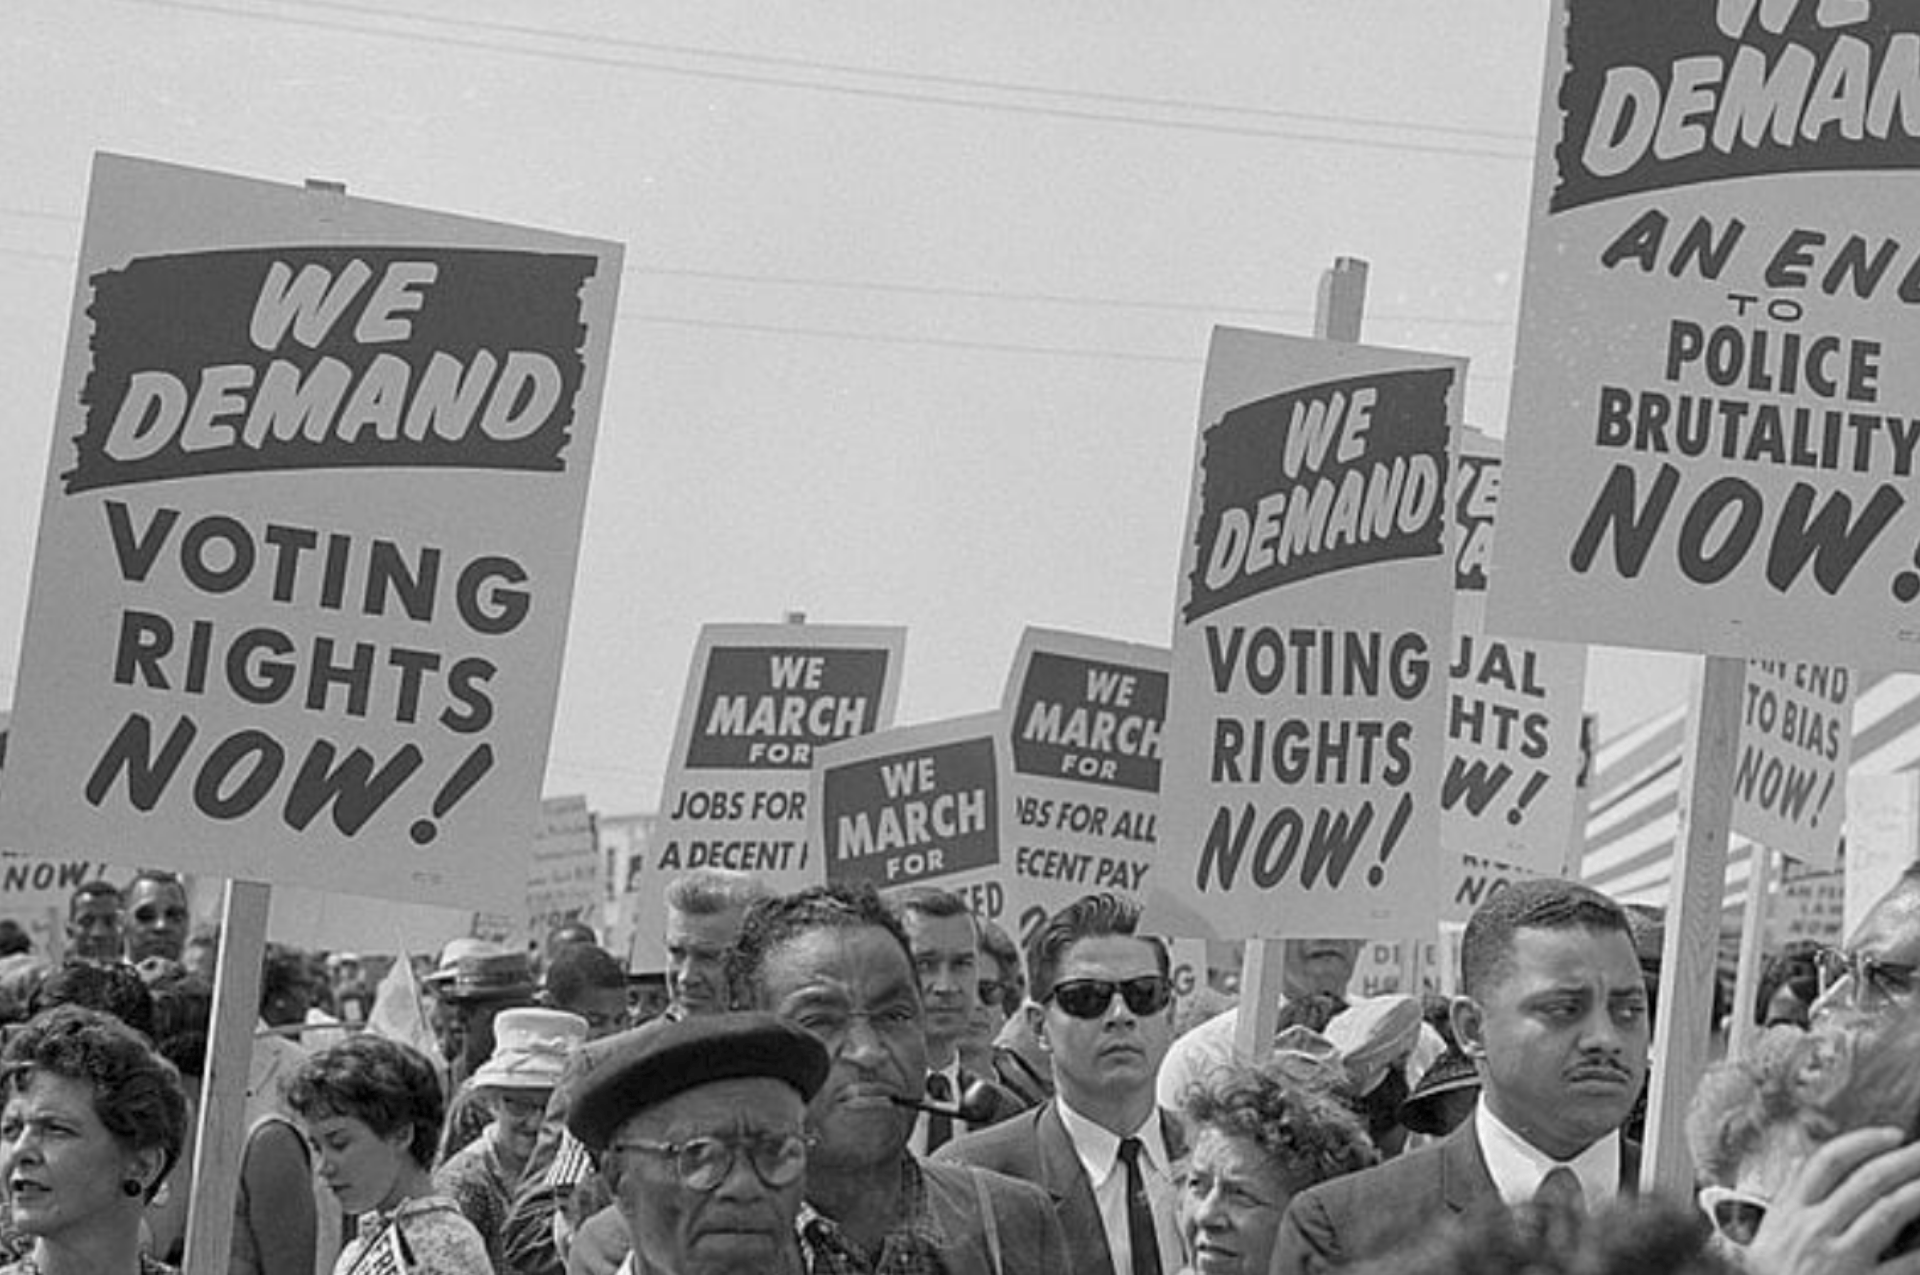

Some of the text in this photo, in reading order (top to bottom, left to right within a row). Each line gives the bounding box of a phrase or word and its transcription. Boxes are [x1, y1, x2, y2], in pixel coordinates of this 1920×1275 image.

[1581, 32, 1920, 177] DEMAN
[1600, 208, 1746, 280] AN
[249, 258, 438, 351] WE
[1728, 293, 1803, 322] TO
[1666, 319, 1882, 403] POLICE
[104, 348, 562, 461] DEMAND
[1283, 387, 1377, 479] WE
[1596, 386, 1920, 476] BRUTALITY
[1205, 454, 1439, 590] DEMAND
[1457, 460, 1499, 517] E
[104, 500, 531, 635] VOTING
[113, 609, 498, 733] RIGHTS
[770, 656, 825, 690] WE
[1086, 670, 1137, 708] WE
[1205, 625, 1430, 700] VOTING
[1795, 663, 1849, 705] END
[705, 696, 866, 737] MARCH
[1023, 703, 1166, 760] MARCH
[1212, 717, 1413, 786] RIGHTS
[1449, 695, 1549, 759] HTS
[1747, 683, 1841, 762] TO BIAS
[85, 712, 494, 845] NOW!
[748, 742, 810, 764] FOR
[880, 758, 935, 799] WE
[1061, 754, 1117, 780] FOR
[1734, 744, 1835, 829] NOW!
[671, 791, 806, 821] JOBS FOR
[838, 789, 986, 860] MARCH
[1056, 802, 1107, 836] FOR
[1113, 809, 1157, 843] ALL
[1441, 754, 1550, 826] W!
[658, 842, 681, 870] A
[687, 842, 793, 871] DECENT
[886, 848, 945, 880] FOR
[1016, 846, 1150, 892] ECENT PAY
[1197, 791, 1412, 892] NOW!
